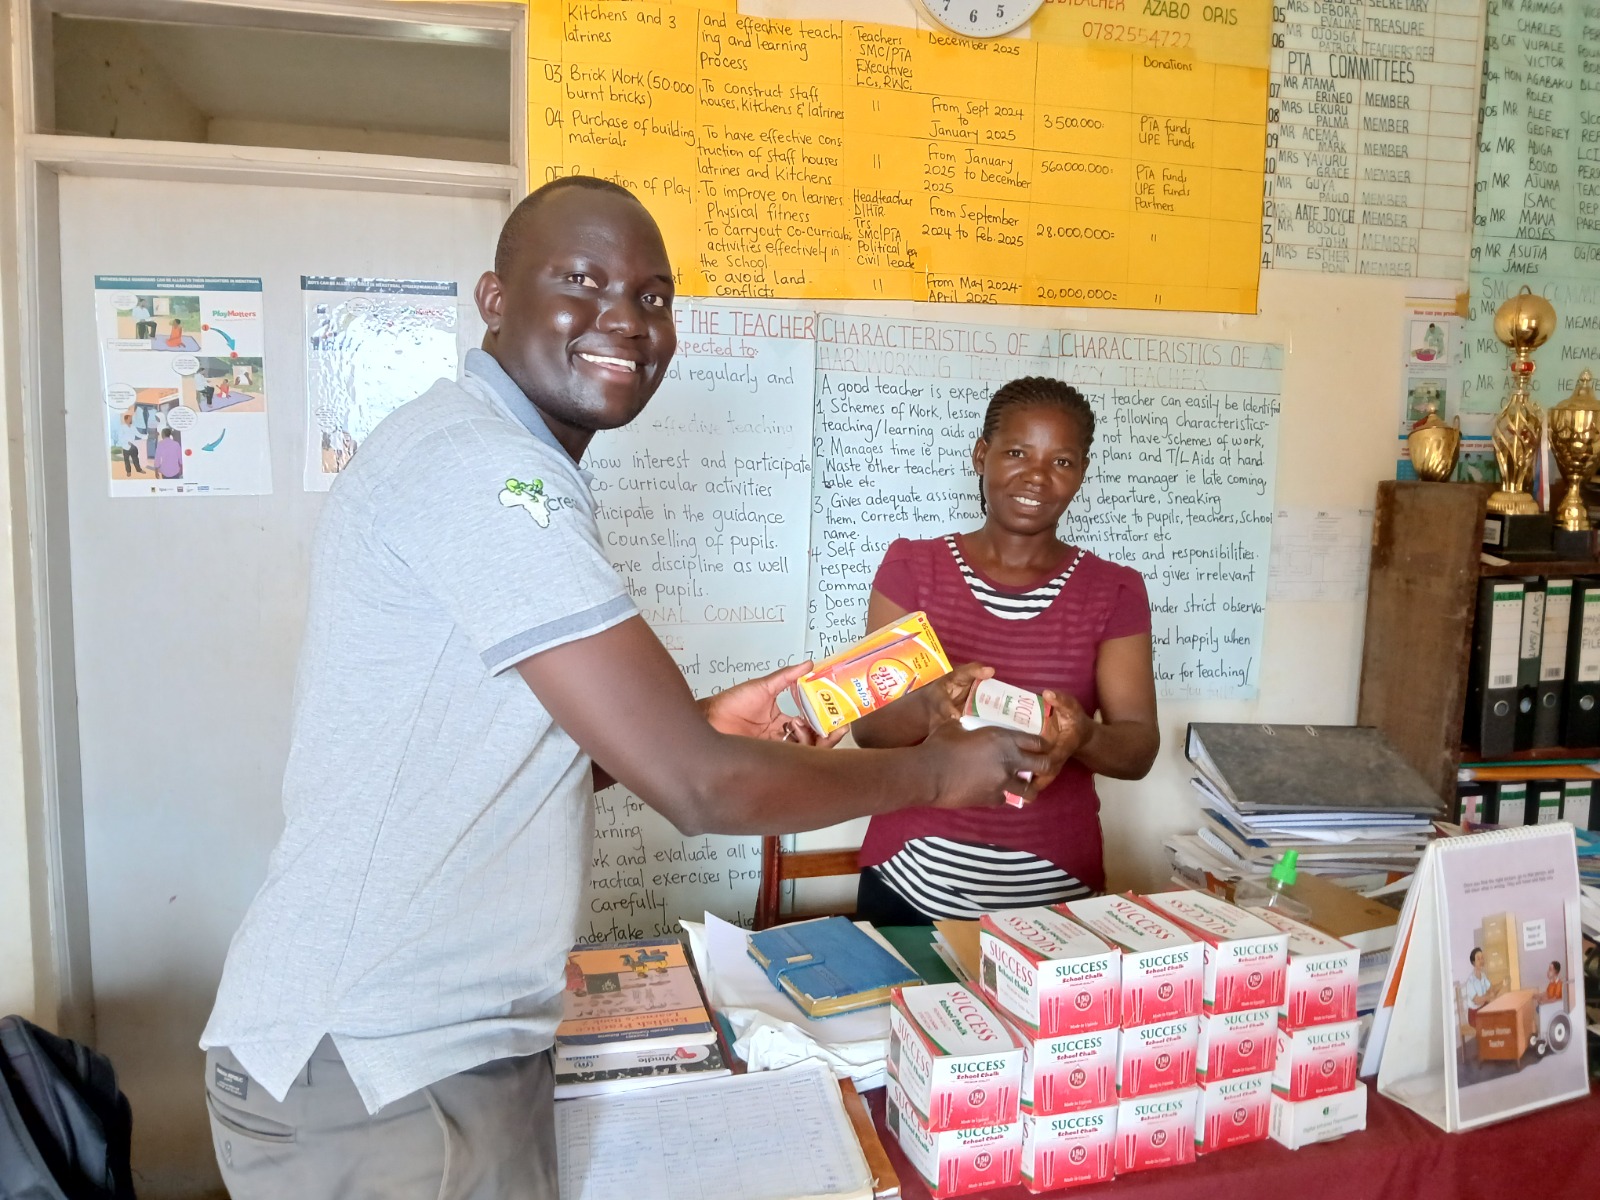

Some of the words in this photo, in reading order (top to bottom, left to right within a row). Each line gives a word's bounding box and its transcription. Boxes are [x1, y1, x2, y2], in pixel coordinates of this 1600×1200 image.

[568, 4, 627, 22] Kitchens
[637, 4, 662, 25] and
[970, 10, 978, 23] 6
[996, 5, 1004, 17] 5
[1143, 1, 1190, 19] AZABO
[1203, 7, 1238, 25] ORIS
[564, 23, 611, 43] latrines
[703, 15, 728, 29] and
[736, 17, 793, 36] effective
[1367, 18, 1424, 36] TREASURE
[1517, 19, 1562, 38] CHARLES
[702, 31, 721, 53] ing
[729, 28, 752, 48] and
[757, 34, 808, 61] learning
[860, 44, 912, 61] SMC/PTA
[994, 42, 1020, 56] 2025
[1144, 56, 1193, 71] Donations
[1288, 52, 1312, 76] PTA
[1329, 54, 1415, 83] COMMITTEES
[544, 64, 562, 82] 03
[570, 66, 607, 82] Brick
[611, 70, 644, 87] Work
[567, 84, 606, 100] burnt
[702, 78, 715, 93] To
[724, 81, 784, 98] construct
[1269, 83, 1280, 98] 07
[1283, 77, 1298, 89] MR
[1302, 78, 1335, 92] ATAMA
[1316, 91, 1352, 104] ERINEO
[1365, 93, 1409, 109] MEMBER
[932, 97, 959, 114] From
[966, 101, 989, 117] Sept
[994, 106, 1024, 120] 2024
[1268, 108, 1279, 123] 08
[1281, 100, 1303, 113] MRS
[1308, 101, 1348, 115] LEKURU
[1503, 101, 1518, 116] MR
[545, 107, 564, 126] 04
[572, 109, 629, 129] Purchase
[652, 118, 695, 145] building
[1141, 116, 1160, 133] PTA
[1316, 115, 1349, 129] PALMA
[1363, 117, 1409, 133] MEMBER
[1527, 123, 1569, 139] GEOFREY
[568, 130, 626, 147] materials
[703, 125, 717, 139] To
[724, 125, 754, 141] have
[759, 129, 812, 145] effective
[929, 120, 978, 143] January
[986, 129, 1016, 141] 2025
[697, 144, 743, 157] truction
[801, 151, 838, 166] houses
[928, 144, 957, 163] From
[965, 148, 1013, 173] January
[697, 157, 740, 177] latrines
[746, 162, 770, 180] and
[924, 164, 956, 179] 2025
[981, 169, 1031, 189] December
[923, 181, 954, 193] 2025
[1493, 174, 1510, 188] MR
[1524, 176, 1560, 191] AJUMA
[929, 195, 957, 217] From
[960, 203, 1019, 227] September
[1295, 205, 1320, 221] AATE
[1323, 205, 1355, 223] JOYCE
[1489, 209, 1505, 222] MR
[1519, 209, 1555, 226] MAWA
[1516, 228, 1555, 241] MOSES
[1485, 245, 1501, 257] MR
[1502, 259, 1539, 274] JAMES
[212, 310, 256, 318] PlayMatters
[691, 310, 719, 334] THE
[729, 312, 815, 339] TEACHER
[822, 317, 997, 354] CHARACTERISTICS
[1008, 332, 1030, 355] OF
[1061, 333, 1221, 366] CHARACTERISTICS
[1231, 345, 1252, 367] OF
[819, 347, 950, 379] HARDWORKING
[690, 363, 757, 393] regularly
[767, 367, 794, 385] and
[1063, 361, 1105, 383] LAZY
[1119, 366, 1208, 390] TEACHER
[838, 380, 869, 400] good
[875, 375, 924, 397] teacher
[948, 401, 980, 419] lesson
[1112, 388, 1155, 407] teacher
[1185, 394, 1220, 418] easily
[1225, 395, 1238, 411] be
[1103, 431, 1122, 444] not
[1130, 427, 1160, 444] have
[831, 437, 883, 463] Manages
[890, 438, 915, 456] time
[1139, 449, 1161, 463] and
[633, 449, 689, 469] interest
[701, 450, 726, 469] and
[735, 451, 812, 479] participate
[706, 476, 772, 497] activities
[1128, 472, 1178, 492] manager
[1203, 468, 1222, 485] late
[866, 489, 922, 510] adequate
[683, 504, 704, 523] the
[713, 502, 785, 532] guidance
[608, 528, 697, 558] Counselling
[1109, 546, 1136, 562] roles
[1142, 544, 1165, 560] and
[652, 552, 723, 579] discipline
[759, 557, 789, 574] well
[1163, 565, 1189, 586] gives
[1196, 562, 1255, 582] irrelevant
[1184, 593, 1216, 613] strict
[704, 604, 786, 622] CONDUCT
[1176, 625, 1219, 652] happily
[617, 846, 647, 866] and
[654, 838, 717, 863] evaluate
[653, 869, 720, 890] exercises
[1232, 942, 1279, 958] SUCCESS
[990, 940, 1033, 987] SUCCESS
[1056, 960, 1108, 978] SUCCESS
[1140, 952, 1189, 970] SUCCESS
[1306, 959, 1348, 973] SUCCESS
[1062, 974, 1082, 983] School
[1084, 972, 1103, 980] Chalk
[1074, 994, 1090, 1002] 150
[947, 991, 998, 1042] SUCCESS
[1224, 1012, 1270, 1026] SUCCESS
[1140, 1023, 1187, 1040] SUCCESS
[1307, 1030, 1350, 1045] SUCCESS
[1051, 1037, 1102, 1054] SUCCESS
[638, 1052, 678, 1064] Windle
[950, 1060, 1006, 1074] SUCCESS
[969, 1092, 985, 1100] 150
[1219, 1079, 1262, 1095] SUCCESS
[1135, 1100, 1183, 1116] SUCCESS
[1052, 1115, 1104, 1131] SUCCESS
